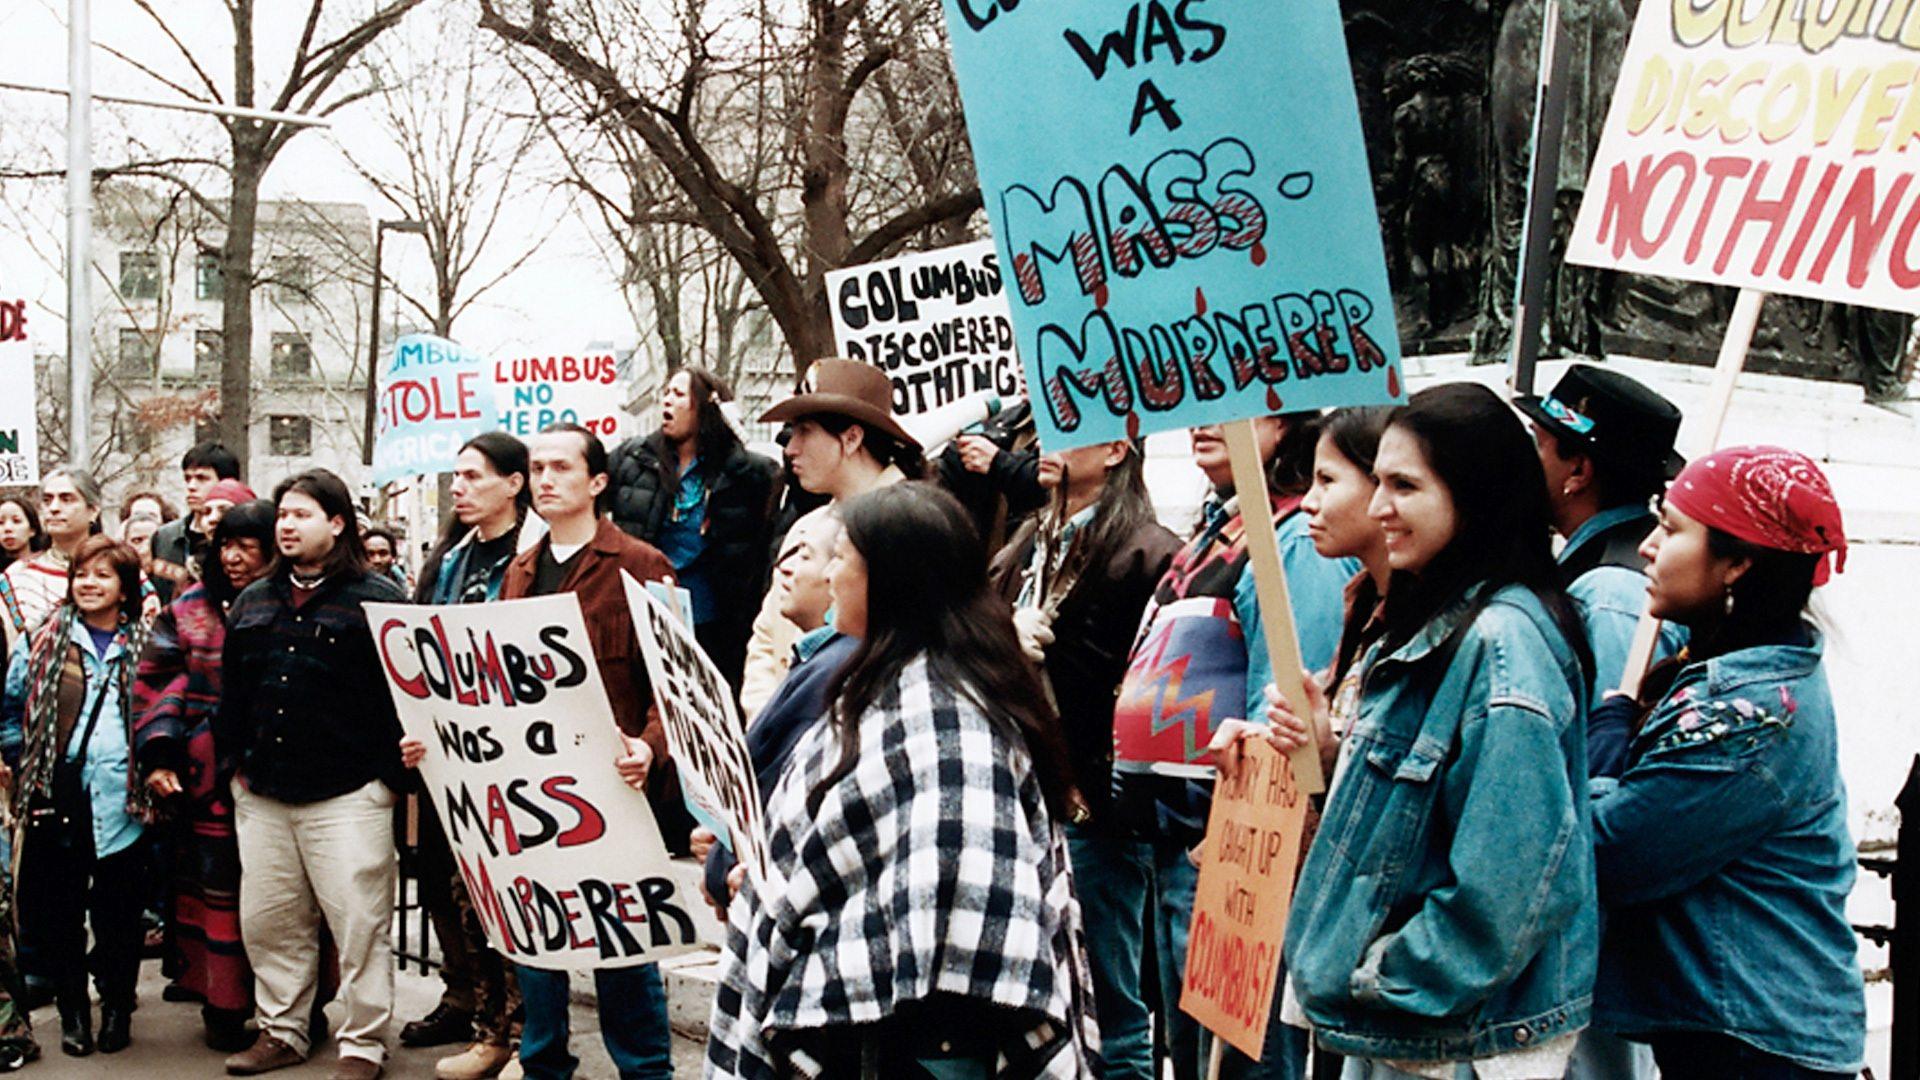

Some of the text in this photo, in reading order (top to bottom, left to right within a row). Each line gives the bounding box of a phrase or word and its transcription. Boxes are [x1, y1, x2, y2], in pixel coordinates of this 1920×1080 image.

[1063, 0, 1227, 80] WAS
[1129, 79, 1183, 137] A
[838, 253, 1004, 330] COLUMBUS
[495, 355, 617, 385] LUMBUS
[845, 315, 1014, 373] DISCOVERED
[1037, 289, 1386, 433] MURDERER
[514, 383, 555, 408] NO
[891, 356, 1017, 416] OTHING
[586, 417, 617, 436] TO
[379, 614, 588, 708] COLUMBUS
[445, 776, 607, 857] MASS
[456, 850, 697, 960] MURDERER
